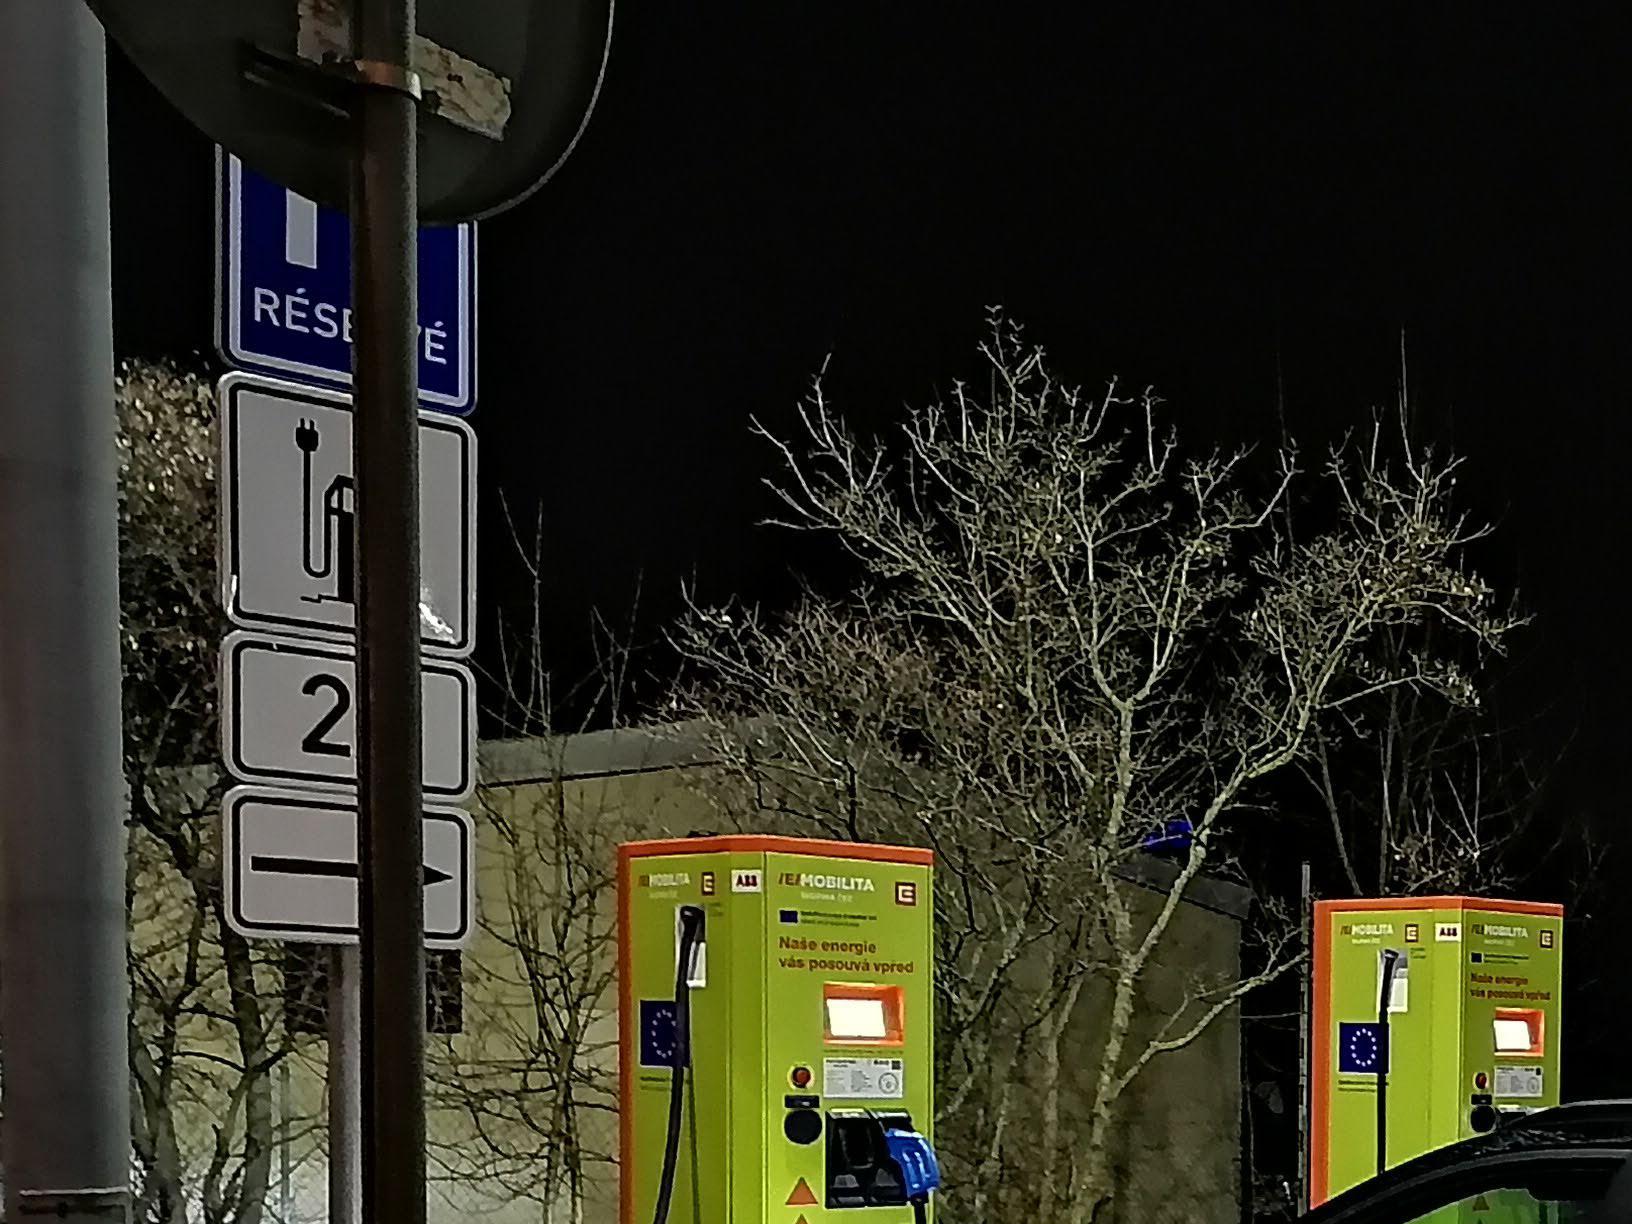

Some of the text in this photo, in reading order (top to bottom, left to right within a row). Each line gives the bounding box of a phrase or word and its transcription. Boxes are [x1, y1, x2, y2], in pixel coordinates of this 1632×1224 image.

[301, 673, 351, 758] 2
[779, 936, 877, 955] Naše energie
[809, 959, 870, 972] posouvá
